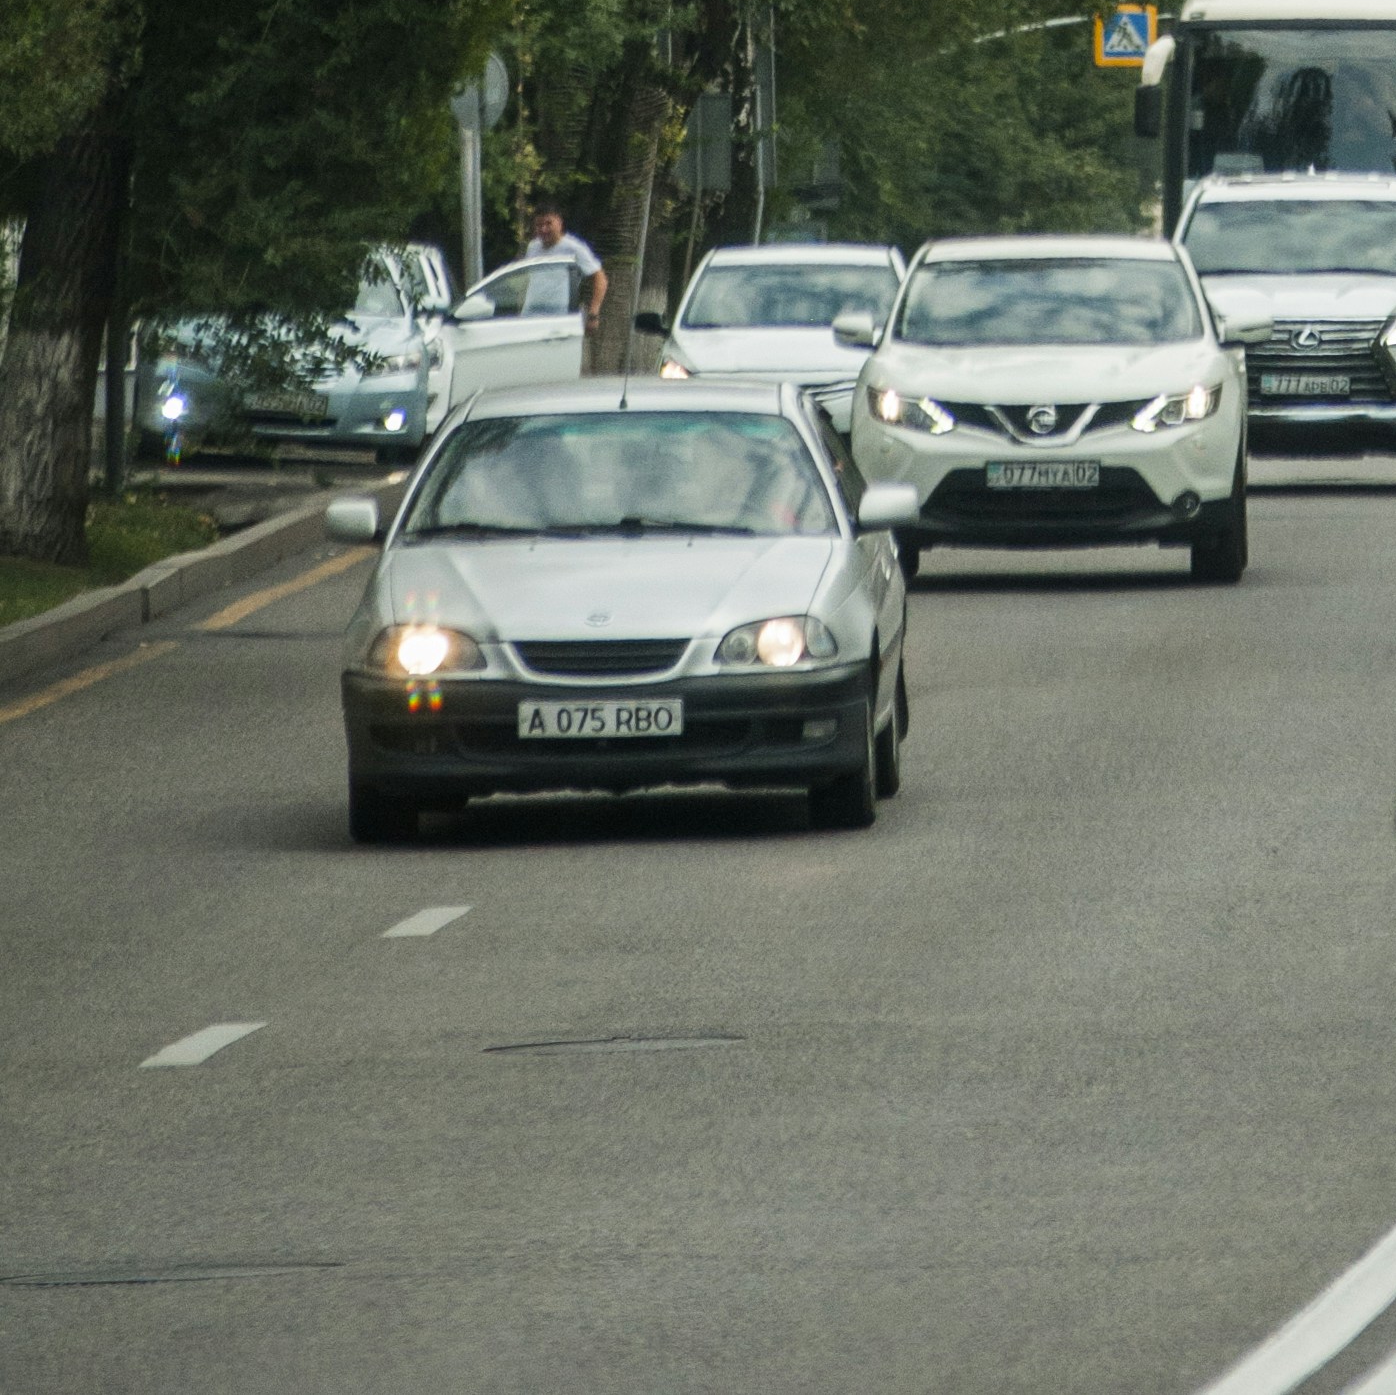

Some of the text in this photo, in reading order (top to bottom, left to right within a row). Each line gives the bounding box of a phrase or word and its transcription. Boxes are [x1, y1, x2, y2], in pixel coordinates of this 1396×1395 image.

[527, 706, 674, 734] A 075 RBO
